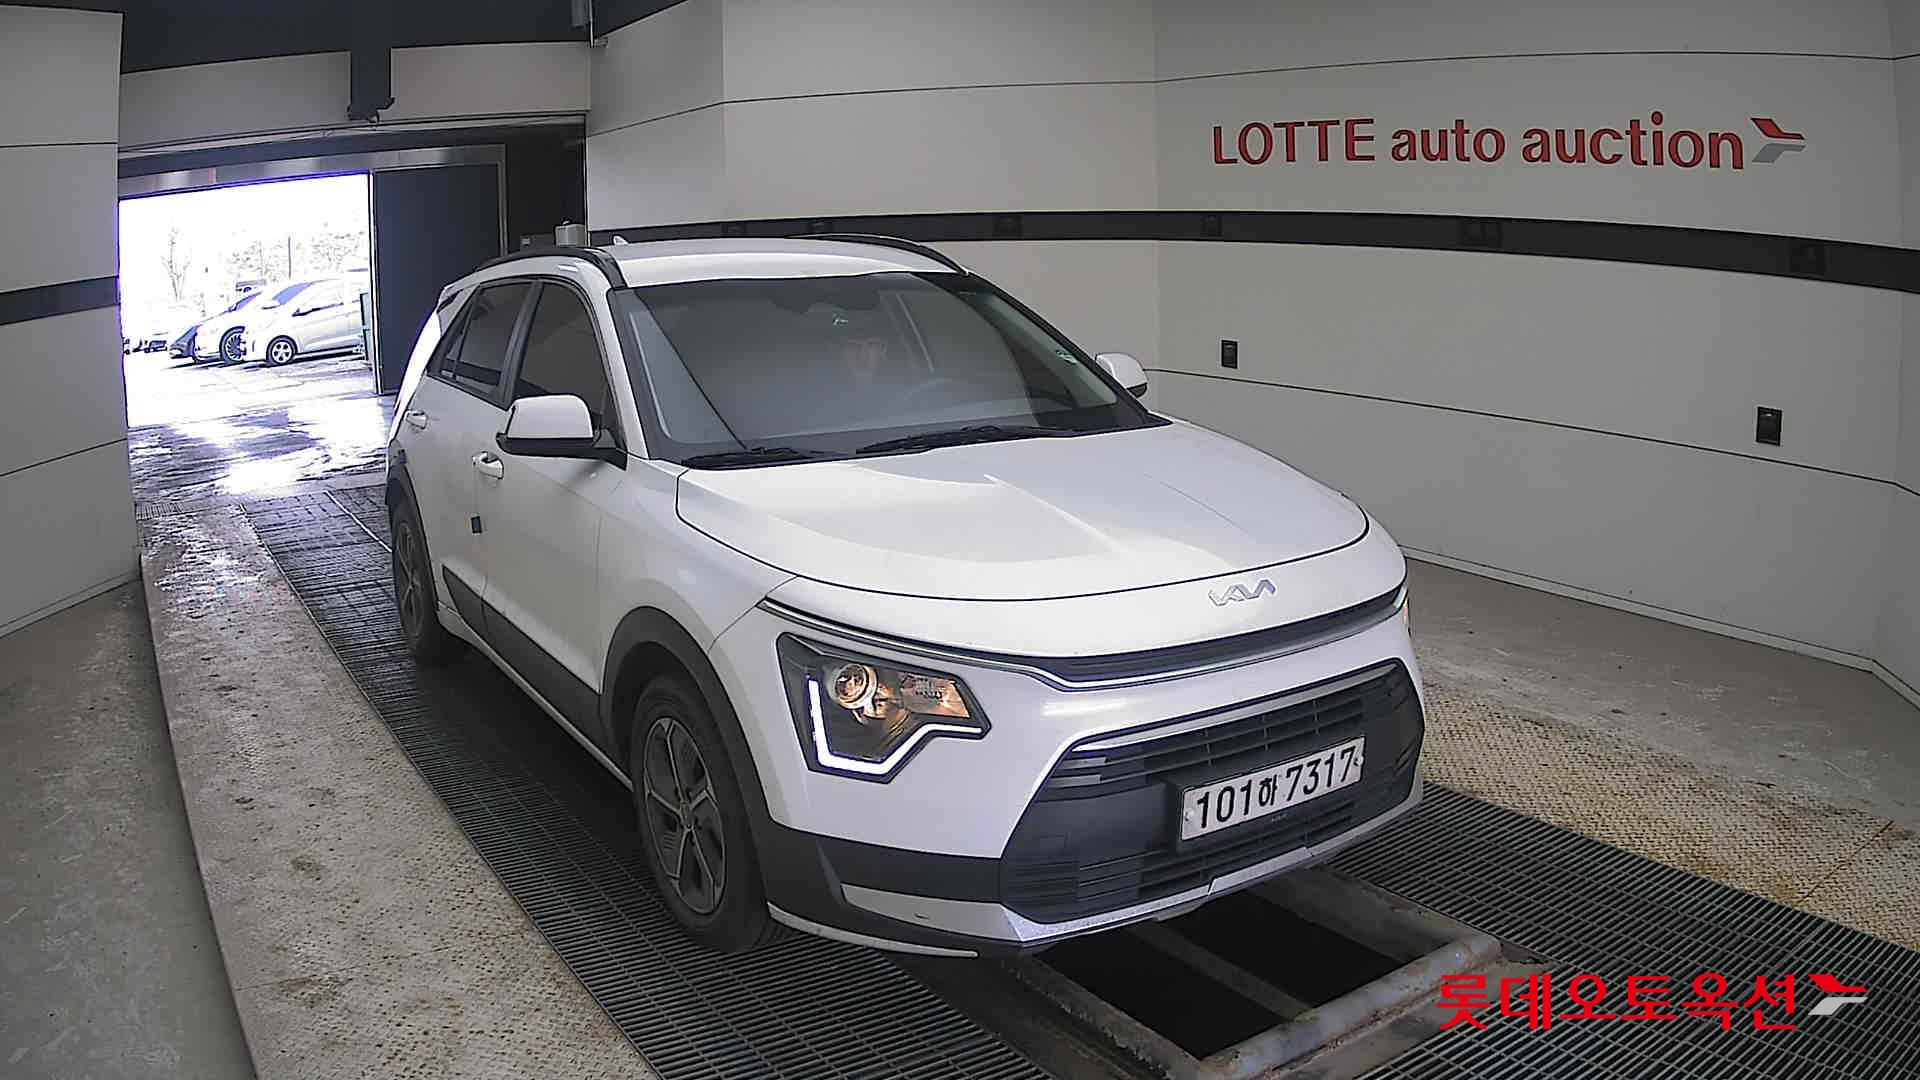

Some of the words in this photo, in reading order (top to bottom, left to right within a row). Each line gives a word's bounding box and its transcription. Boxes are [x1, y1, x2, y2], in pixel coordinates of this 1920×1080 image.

[1213, 119, 1375, 164] LOTTE
[1391, 119, 1505, 162] auto
[1521, 111, 1743, 169] auction
